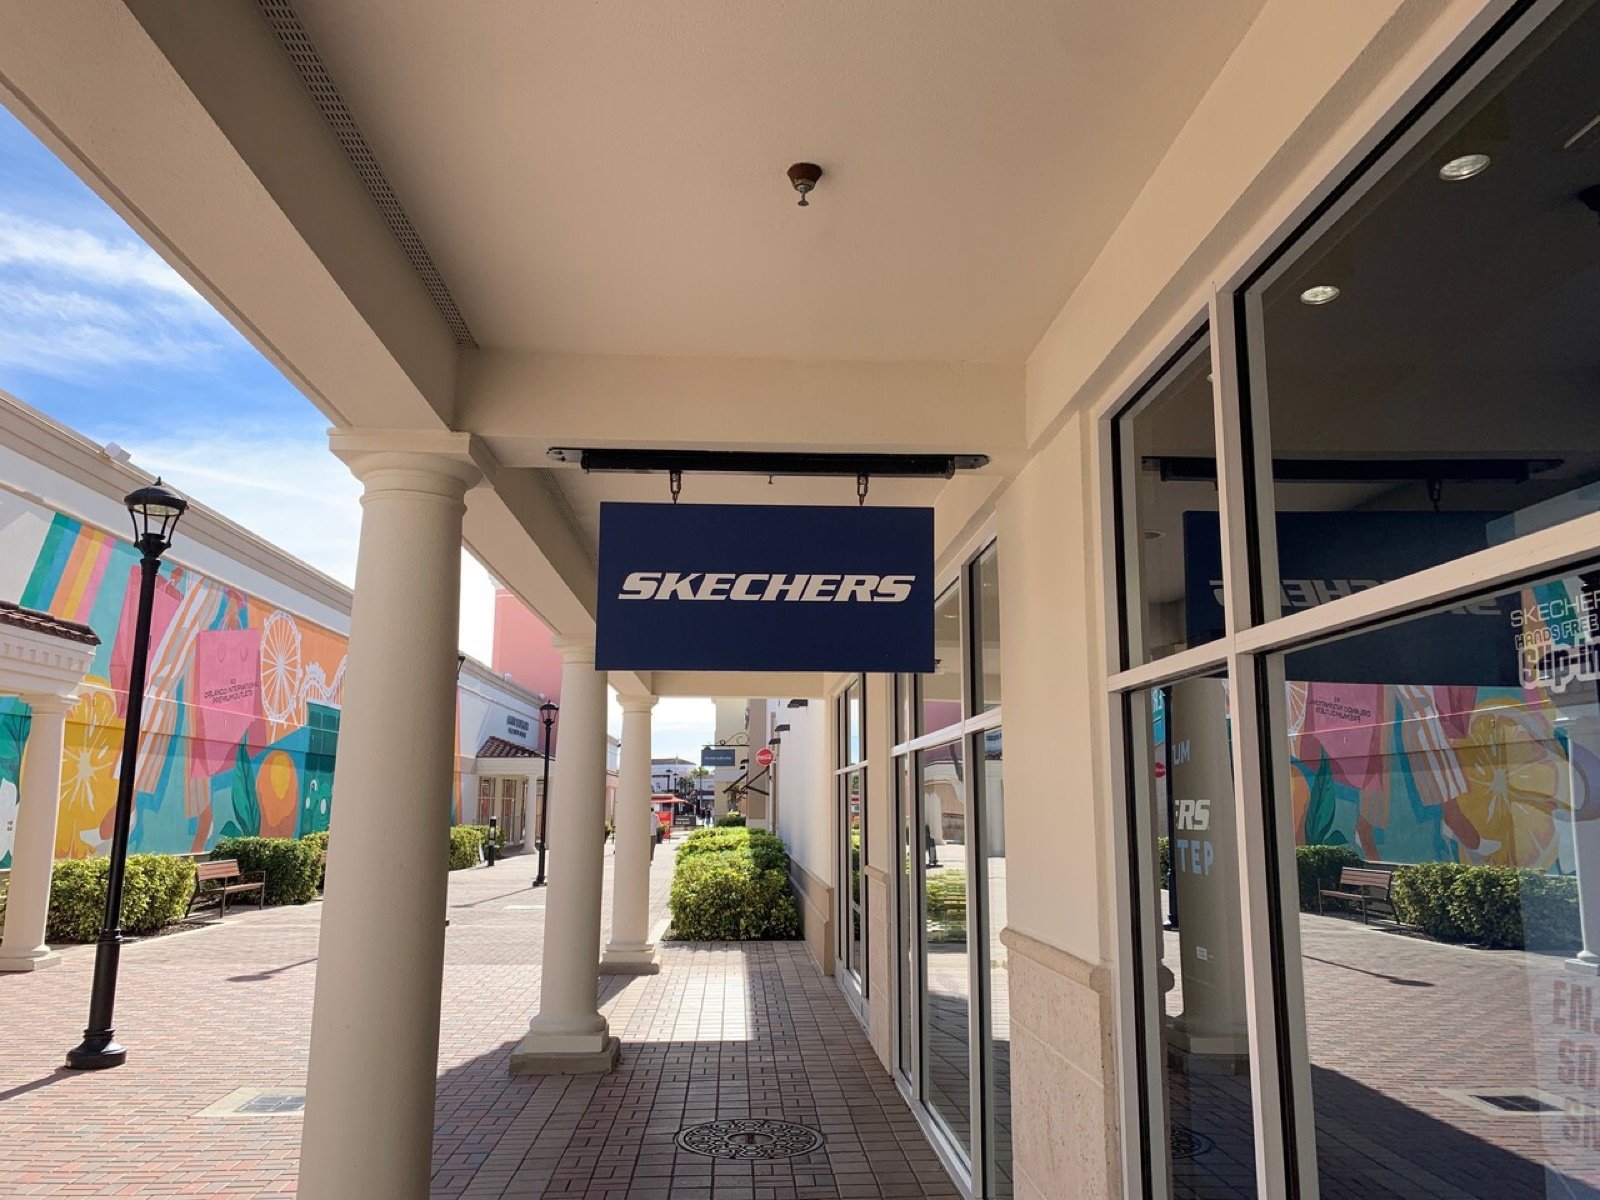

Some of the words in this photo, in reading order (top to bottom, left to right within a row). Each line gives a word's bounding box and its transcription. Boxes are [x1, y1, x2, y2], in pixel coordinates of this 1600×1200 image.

[617, 571, 916, 603] SKECHERS
[1515, 624, 1561, 650] HANDS
[1562, 613, 1599, 638] FREE
